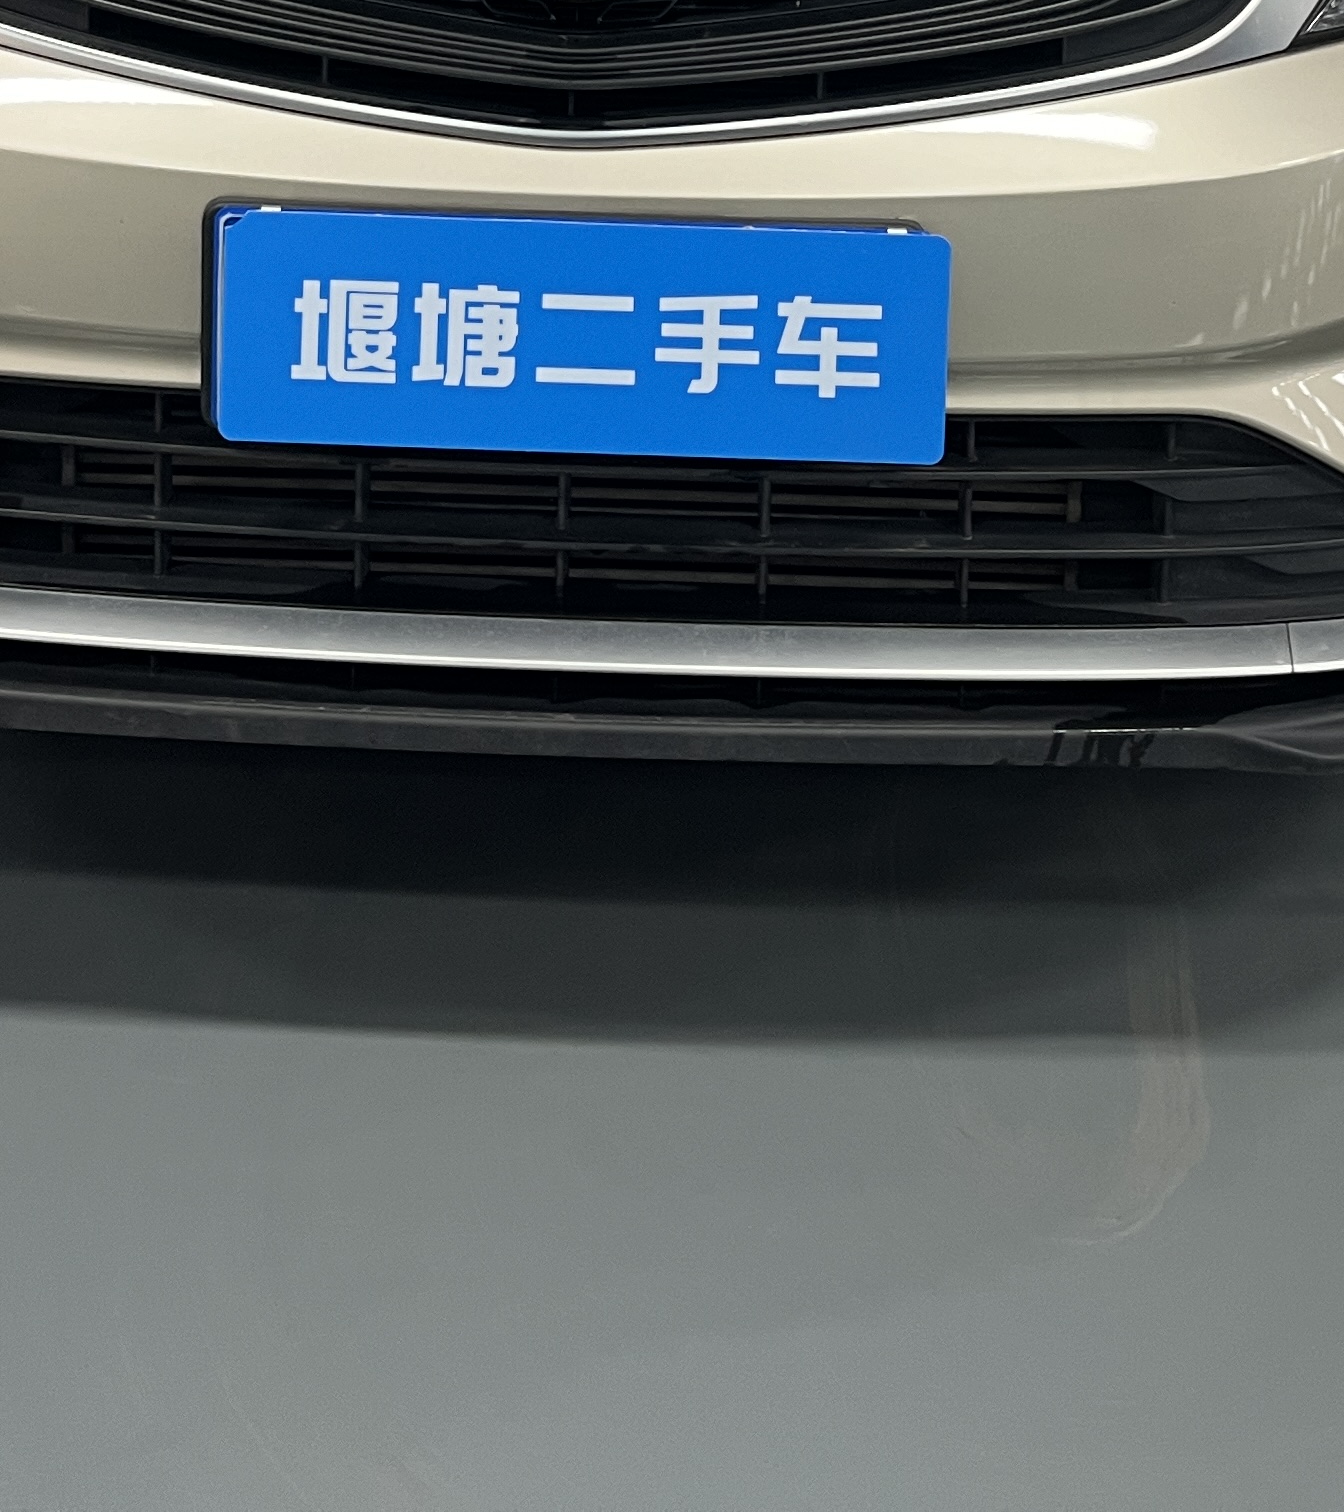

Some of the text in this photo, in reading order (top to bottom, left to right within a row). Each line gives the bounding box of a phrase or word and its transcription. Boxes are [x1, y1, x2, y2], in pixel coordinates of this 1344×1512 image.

[291, 279, 883, 399] 堰塘二手车
